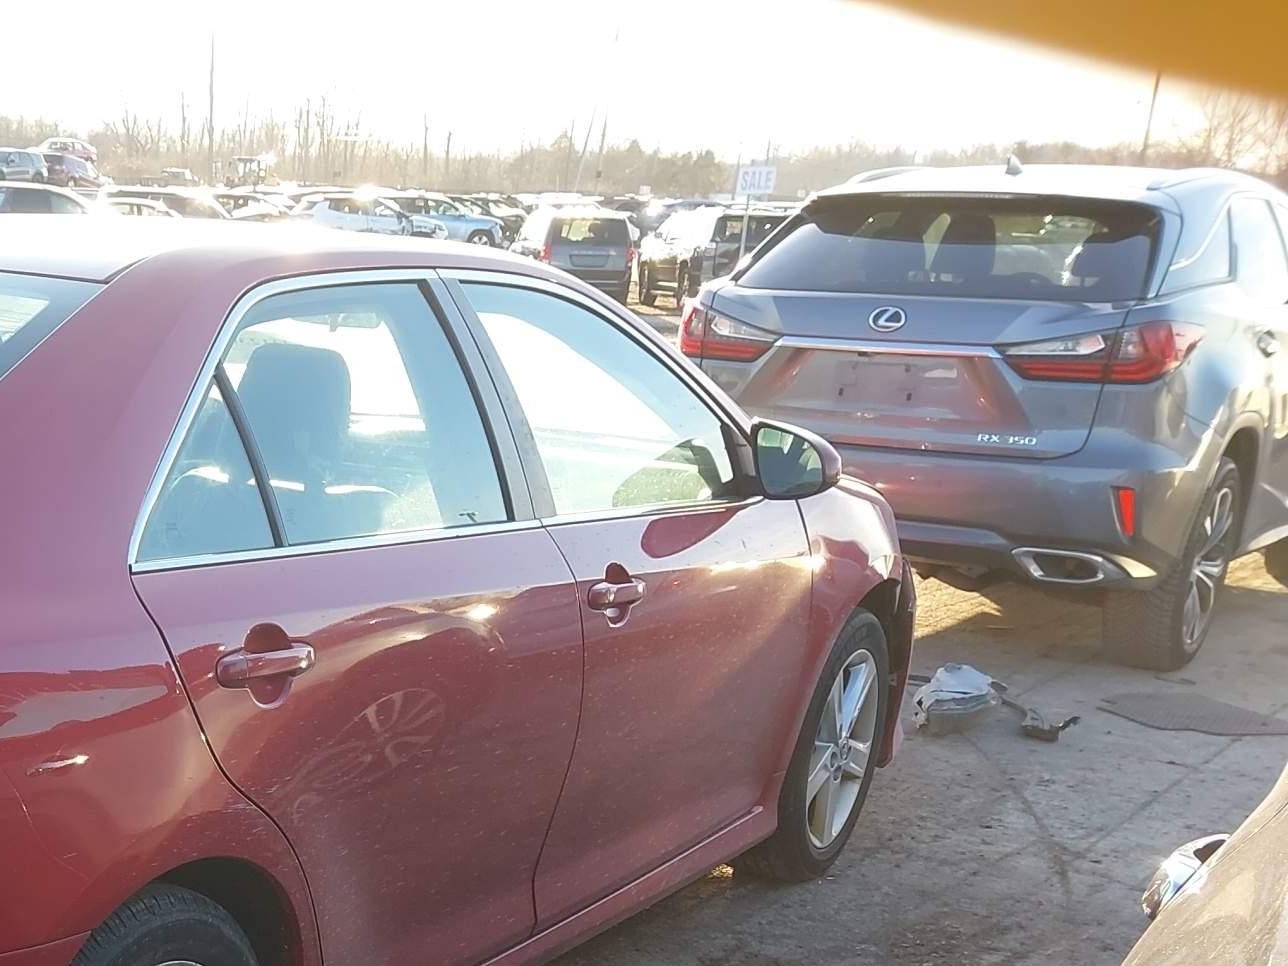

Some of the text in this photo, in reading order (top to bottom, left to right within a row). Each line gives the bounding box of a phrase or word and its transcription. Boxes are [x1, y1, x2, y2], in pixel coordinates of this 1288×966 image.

[741, 170, 773, 191] SALE
[977, 433, 1037, 446] RX 350
